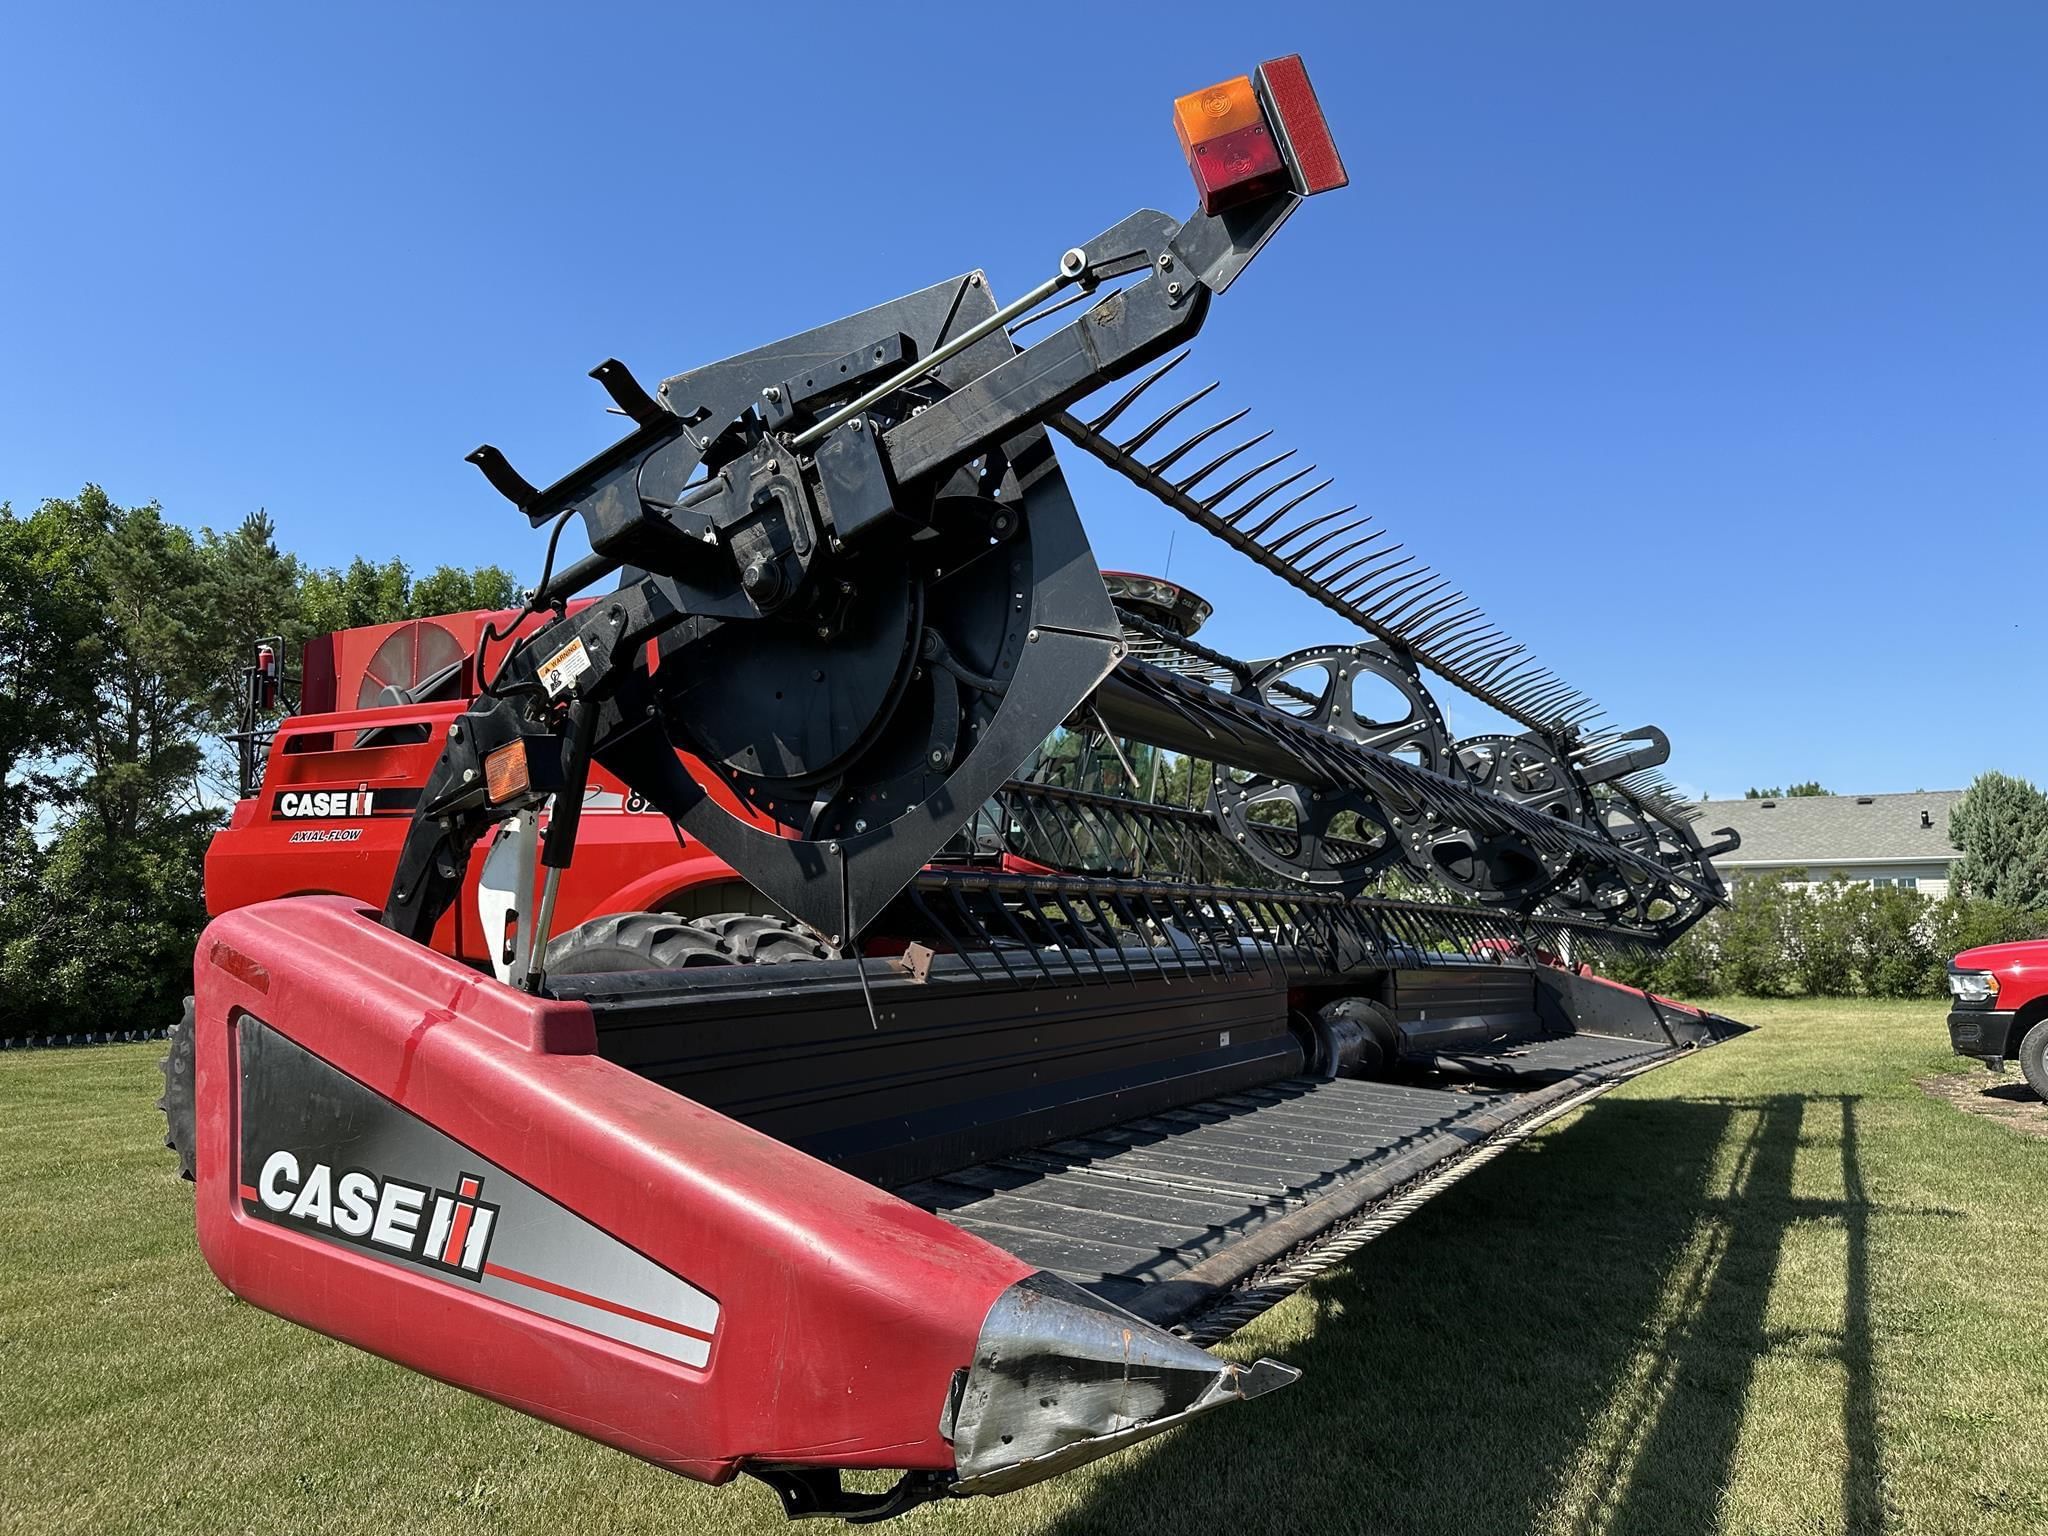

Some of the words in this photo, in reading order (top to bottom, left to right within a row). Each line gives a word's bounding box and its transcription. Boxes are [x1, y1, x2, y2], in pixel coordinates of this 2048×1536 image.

[551, 643, 577, 667] WARNING
[280, 792, 348, 817] CASE
[289, 829, 362, 843] AXIAL-FLOW
[258, 1150, 428, 1252] CASE
